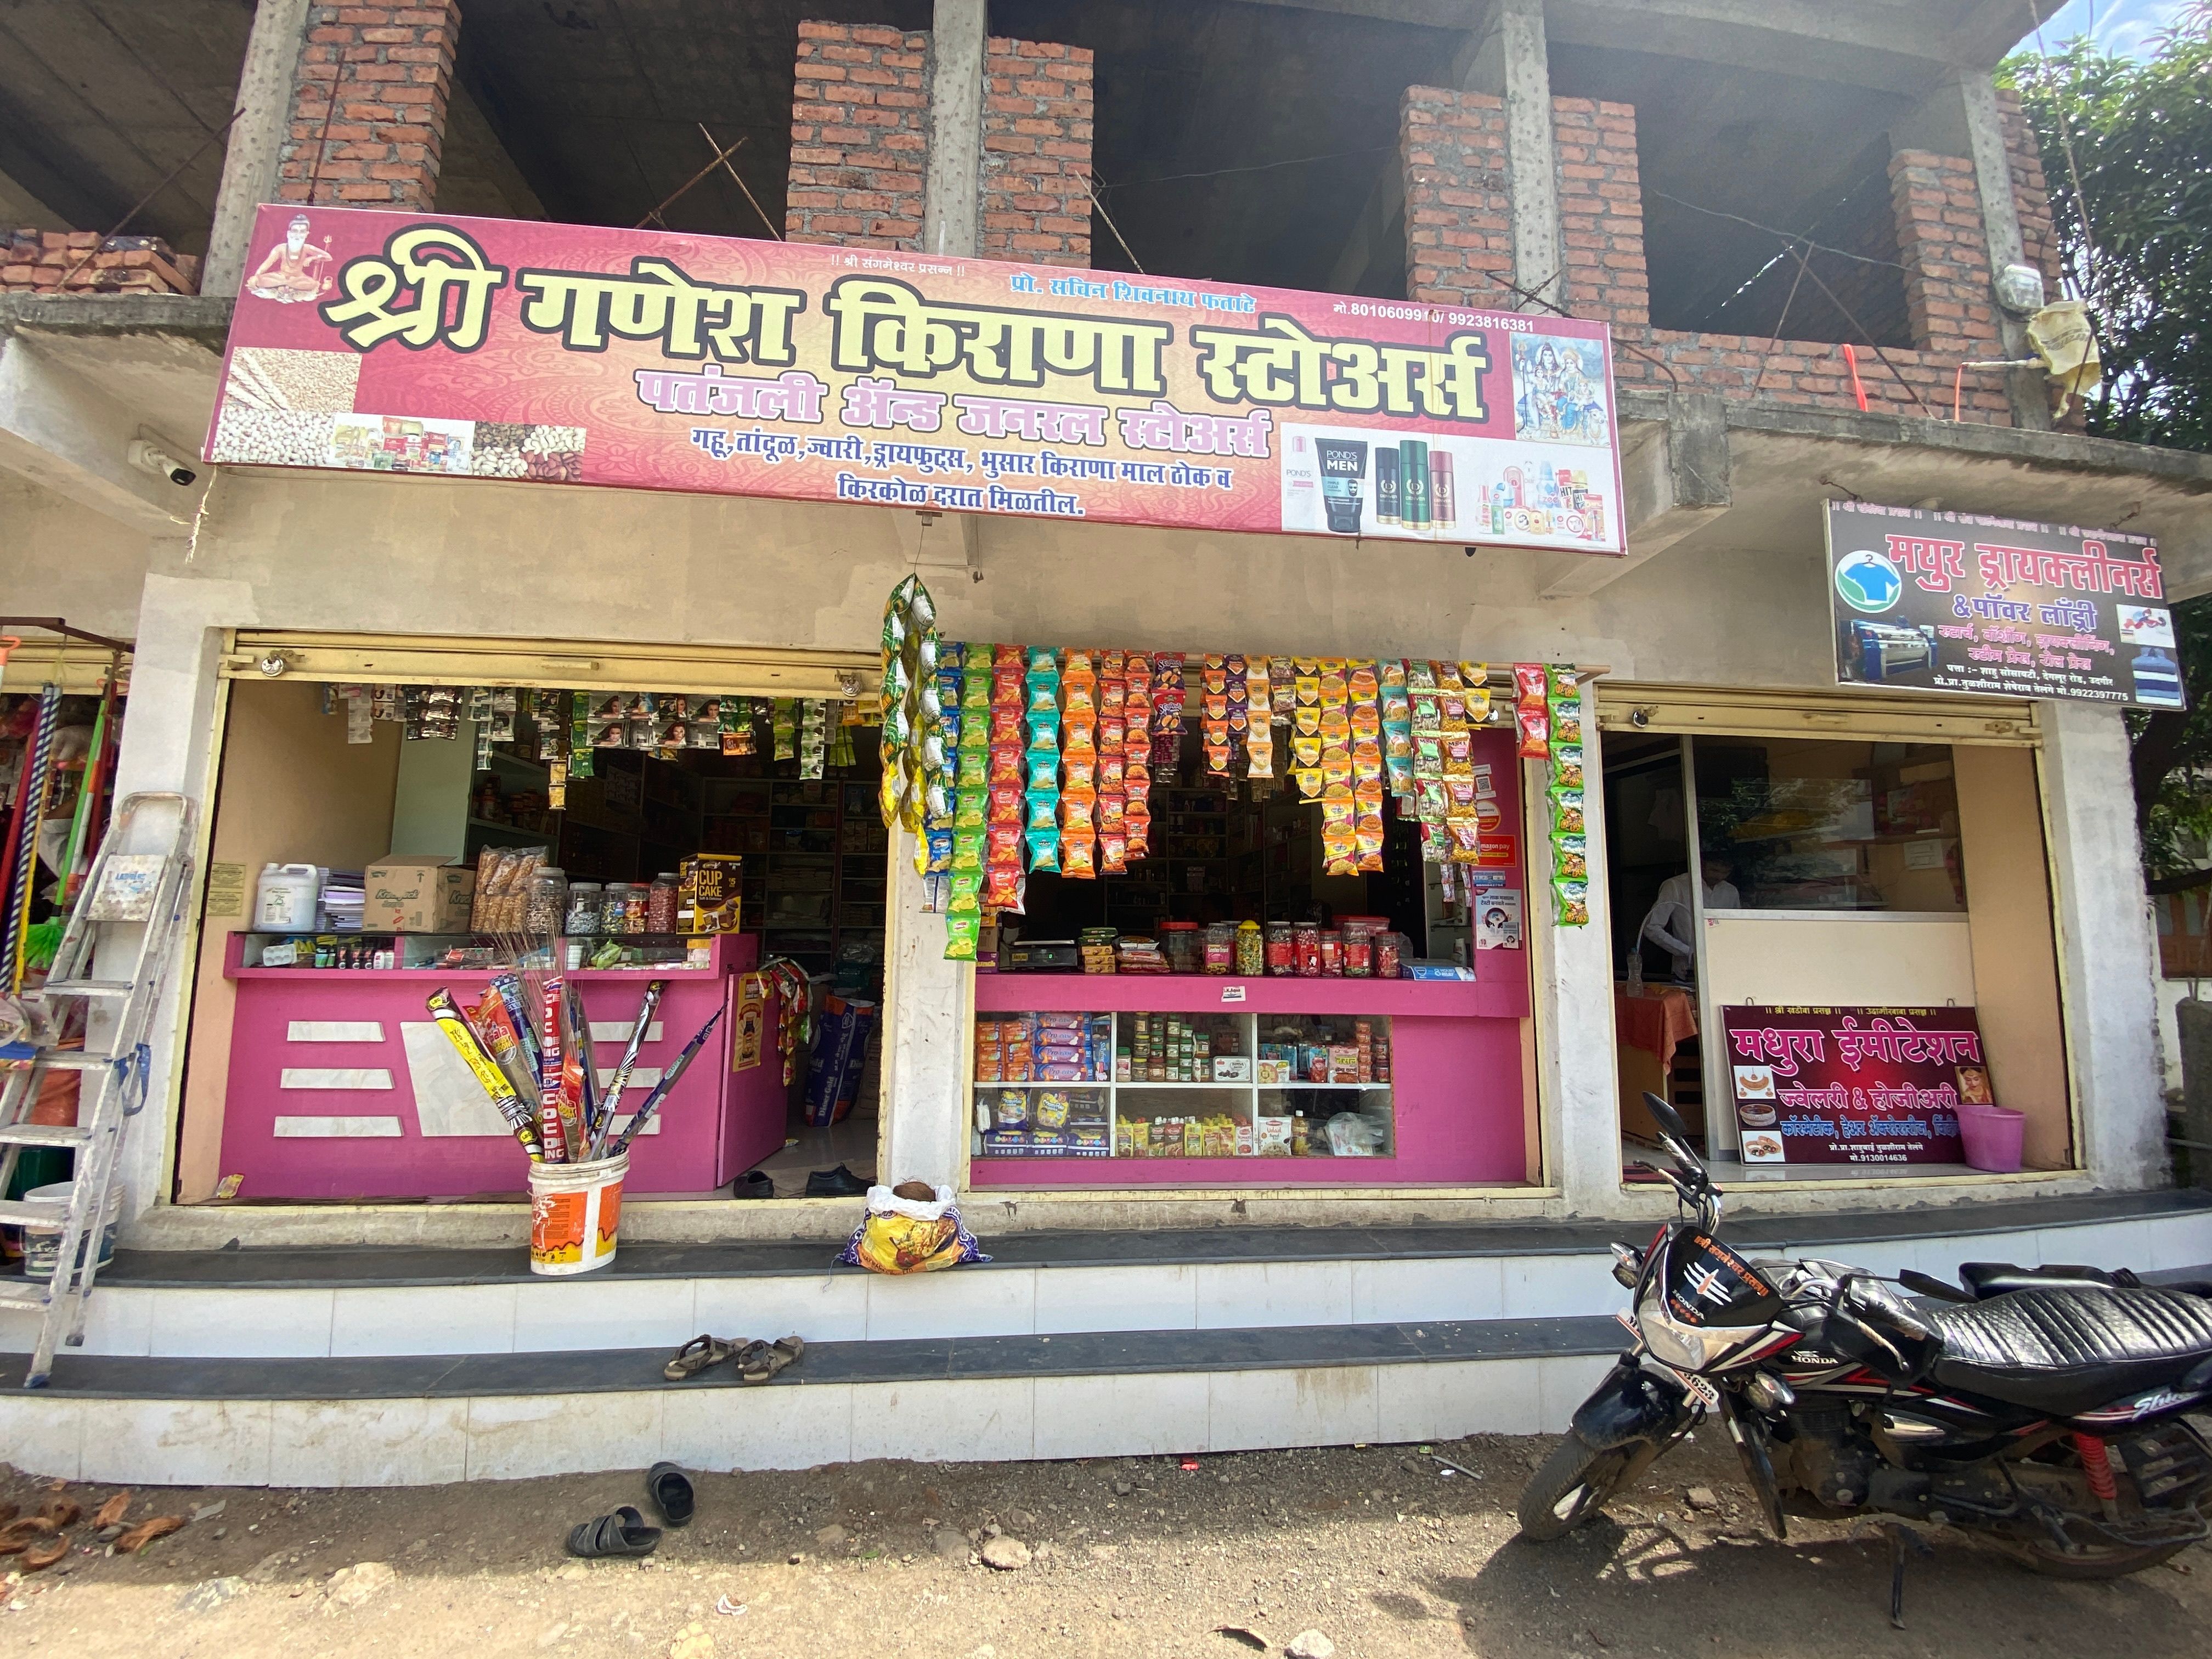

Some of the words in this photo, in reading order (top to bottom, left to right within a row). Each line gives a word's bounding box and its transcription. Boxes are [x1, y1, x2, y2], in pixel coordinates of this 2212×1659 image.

[843, 255, 859, 269] श्री
[862, 257, 916, 274] संगमेश्वर
[919, 262, 953, 277] प्रसन्न
[1011, 273, 1043, 295] प्रो.
[1050, 277, 1108, 301] सचिन
[1113, 280, 1195, 308] शिवनाथ
[1200, 290, 1256, 314] फताटे
[318, 223, 509, 354] श्री
[518, 256, 806, 366] गणेश
[824, 273, 1173, 399] किराणा
[1190, 312, 1493, 424] स्टोअर्स
[1449, 312, 1534, 333] 9923816381
[634, 363, 829, 425] पतंजली
[952, 393, 1109, 447] जनरल
[1119, 401, 1274, 460] स्टोअर्स
[1326, 450, 1358, 460] POND'S
[1327, 460, 1358, 472] MEN
[979, 449, 1036, 479] भुसार
[1041, 450, 1116, 482] किराणा
[1121, 459, 1165, 484] माल
[1170, 460, 1211, 488] ठोक
[1215, 469, 1234, 490] व
[1286, 469, 1312, 477] POND'S
[837, 472, 928, 504] किरकोळ
[933, 481, 983, 509] दरात
[988, 481, 1086, 516] मिळतील.
[1560, 486, 1572, 497] HIT
[1885, 534, 1966, 593] मयुर
[1974, 540, 2162, 600] ड्रायक्लीनर्स
[698, 870, 723, 885] CUP
[698, 885, 723, 897] CAKE
[1729, 1027, 1825, 1077] मधुरा
[1831, 1015, 1980, 1072] ईमीटेशन
[1777, 1080, 1850, 1110] ज्वेलरी
[1852, 1087, 1868, 1110] &
[1868, 1080, 1958, 1112] होजीअरी
[1672, 1289, 1706, 1321] HONDA
[1791, 1355, 1839, 1364] HONDA
